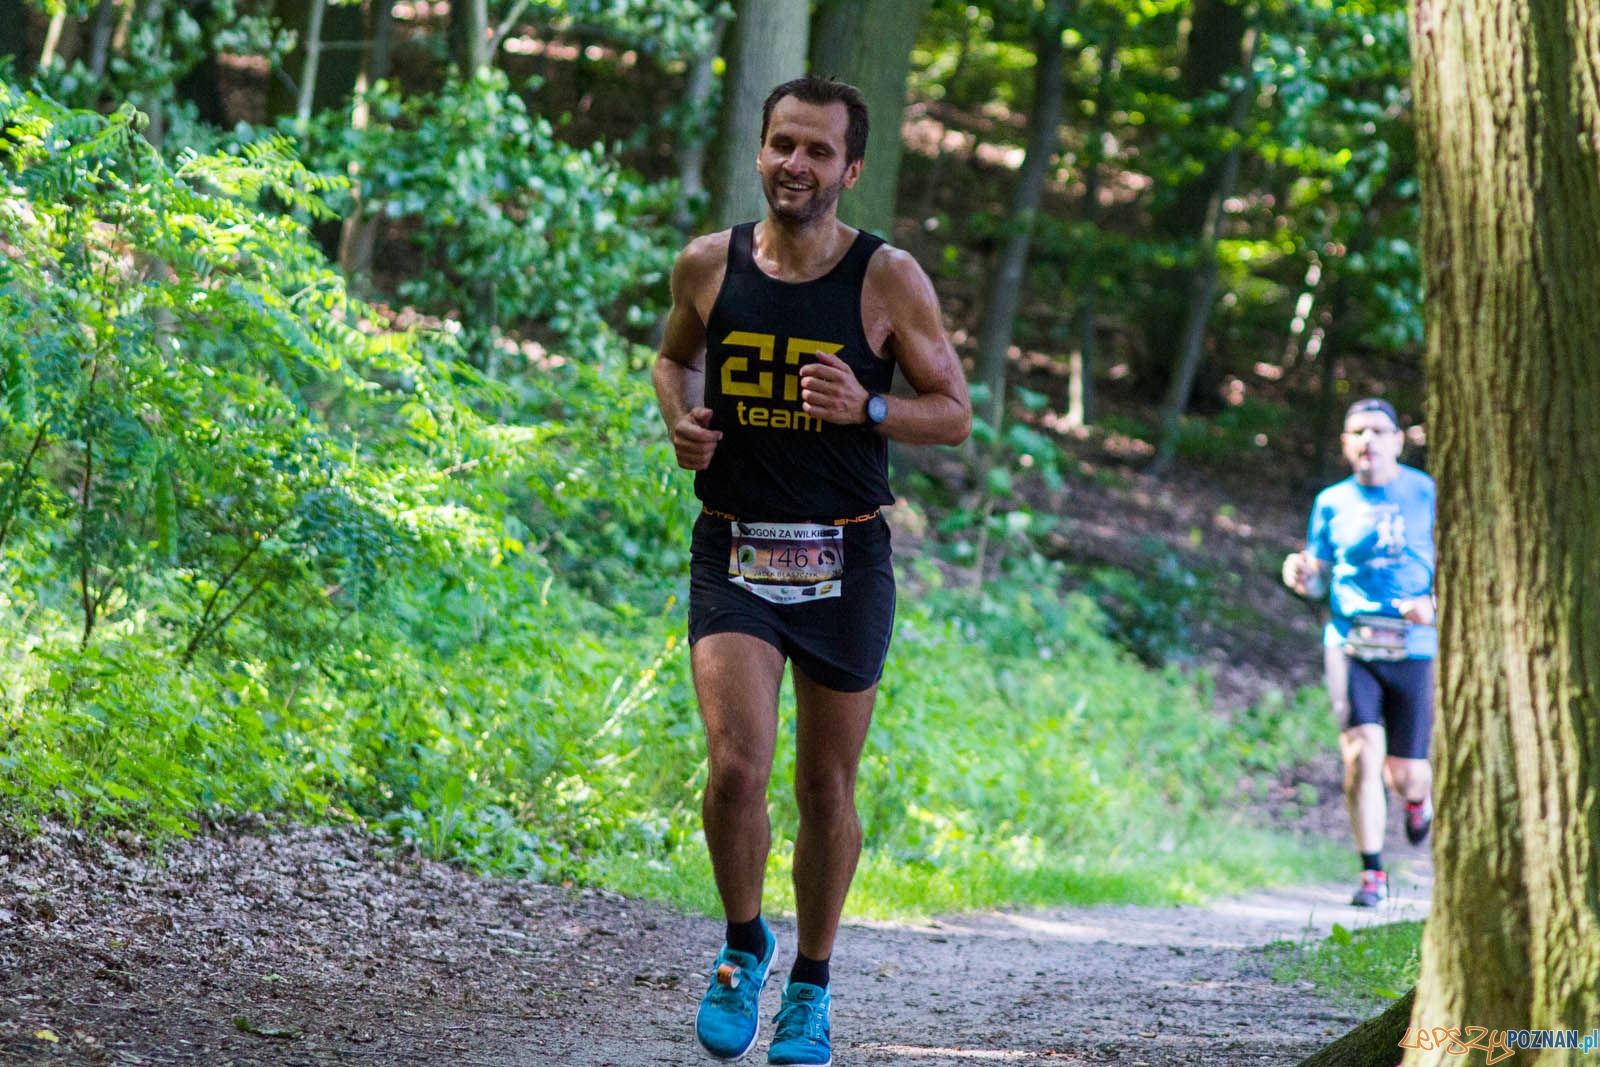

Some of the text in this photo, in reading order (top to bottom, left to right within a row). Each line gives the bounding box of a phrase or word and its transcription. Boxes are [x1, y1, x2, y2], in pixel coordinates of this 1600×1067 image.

[736, 401, 823, 432] team
[742, 527, 776, 538] OGOŃ
[778, 529, 791, 539] ZA
[768, 546, 809, 568] 146
